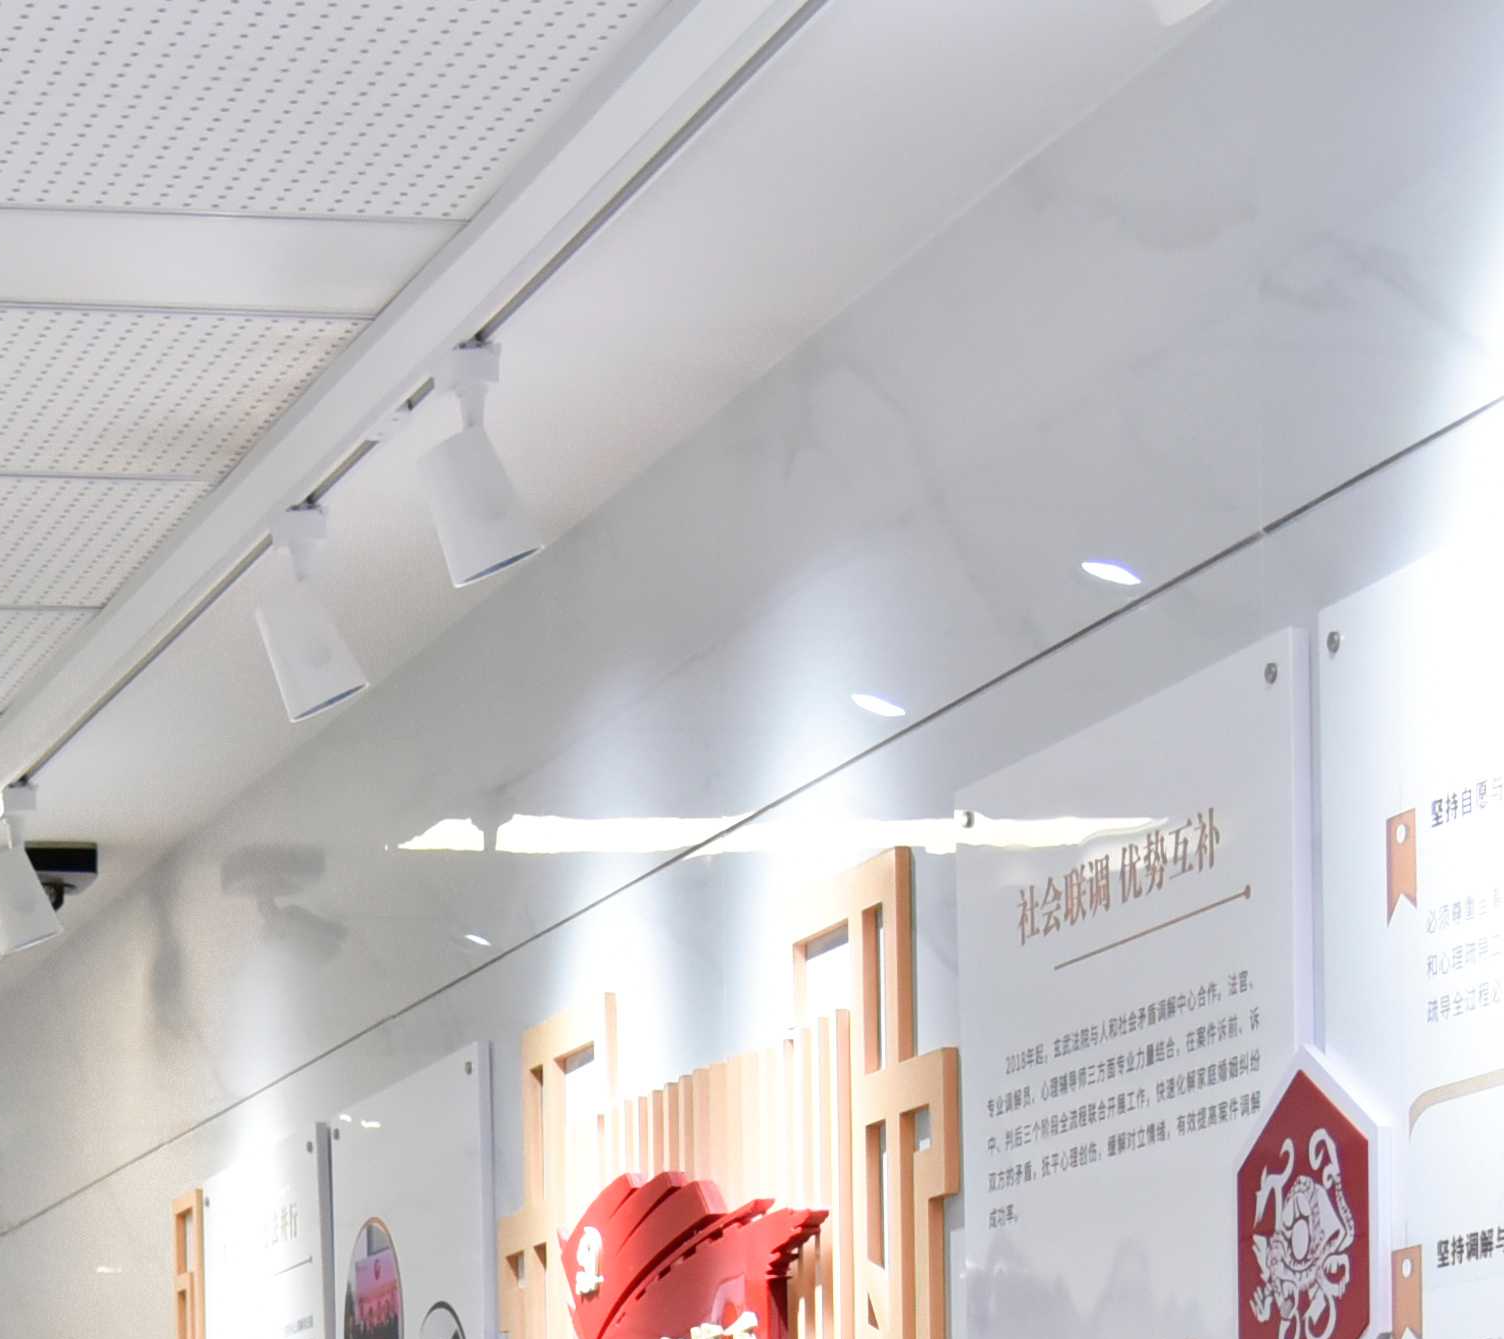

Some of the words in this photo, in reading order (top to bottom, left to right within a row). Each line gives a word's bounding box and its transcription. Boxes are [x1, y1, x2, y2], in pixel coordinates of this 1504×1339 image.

[1017, 853, 1111, 946] 社会联调
[1119, 806, 1220, 903] 优势互补
